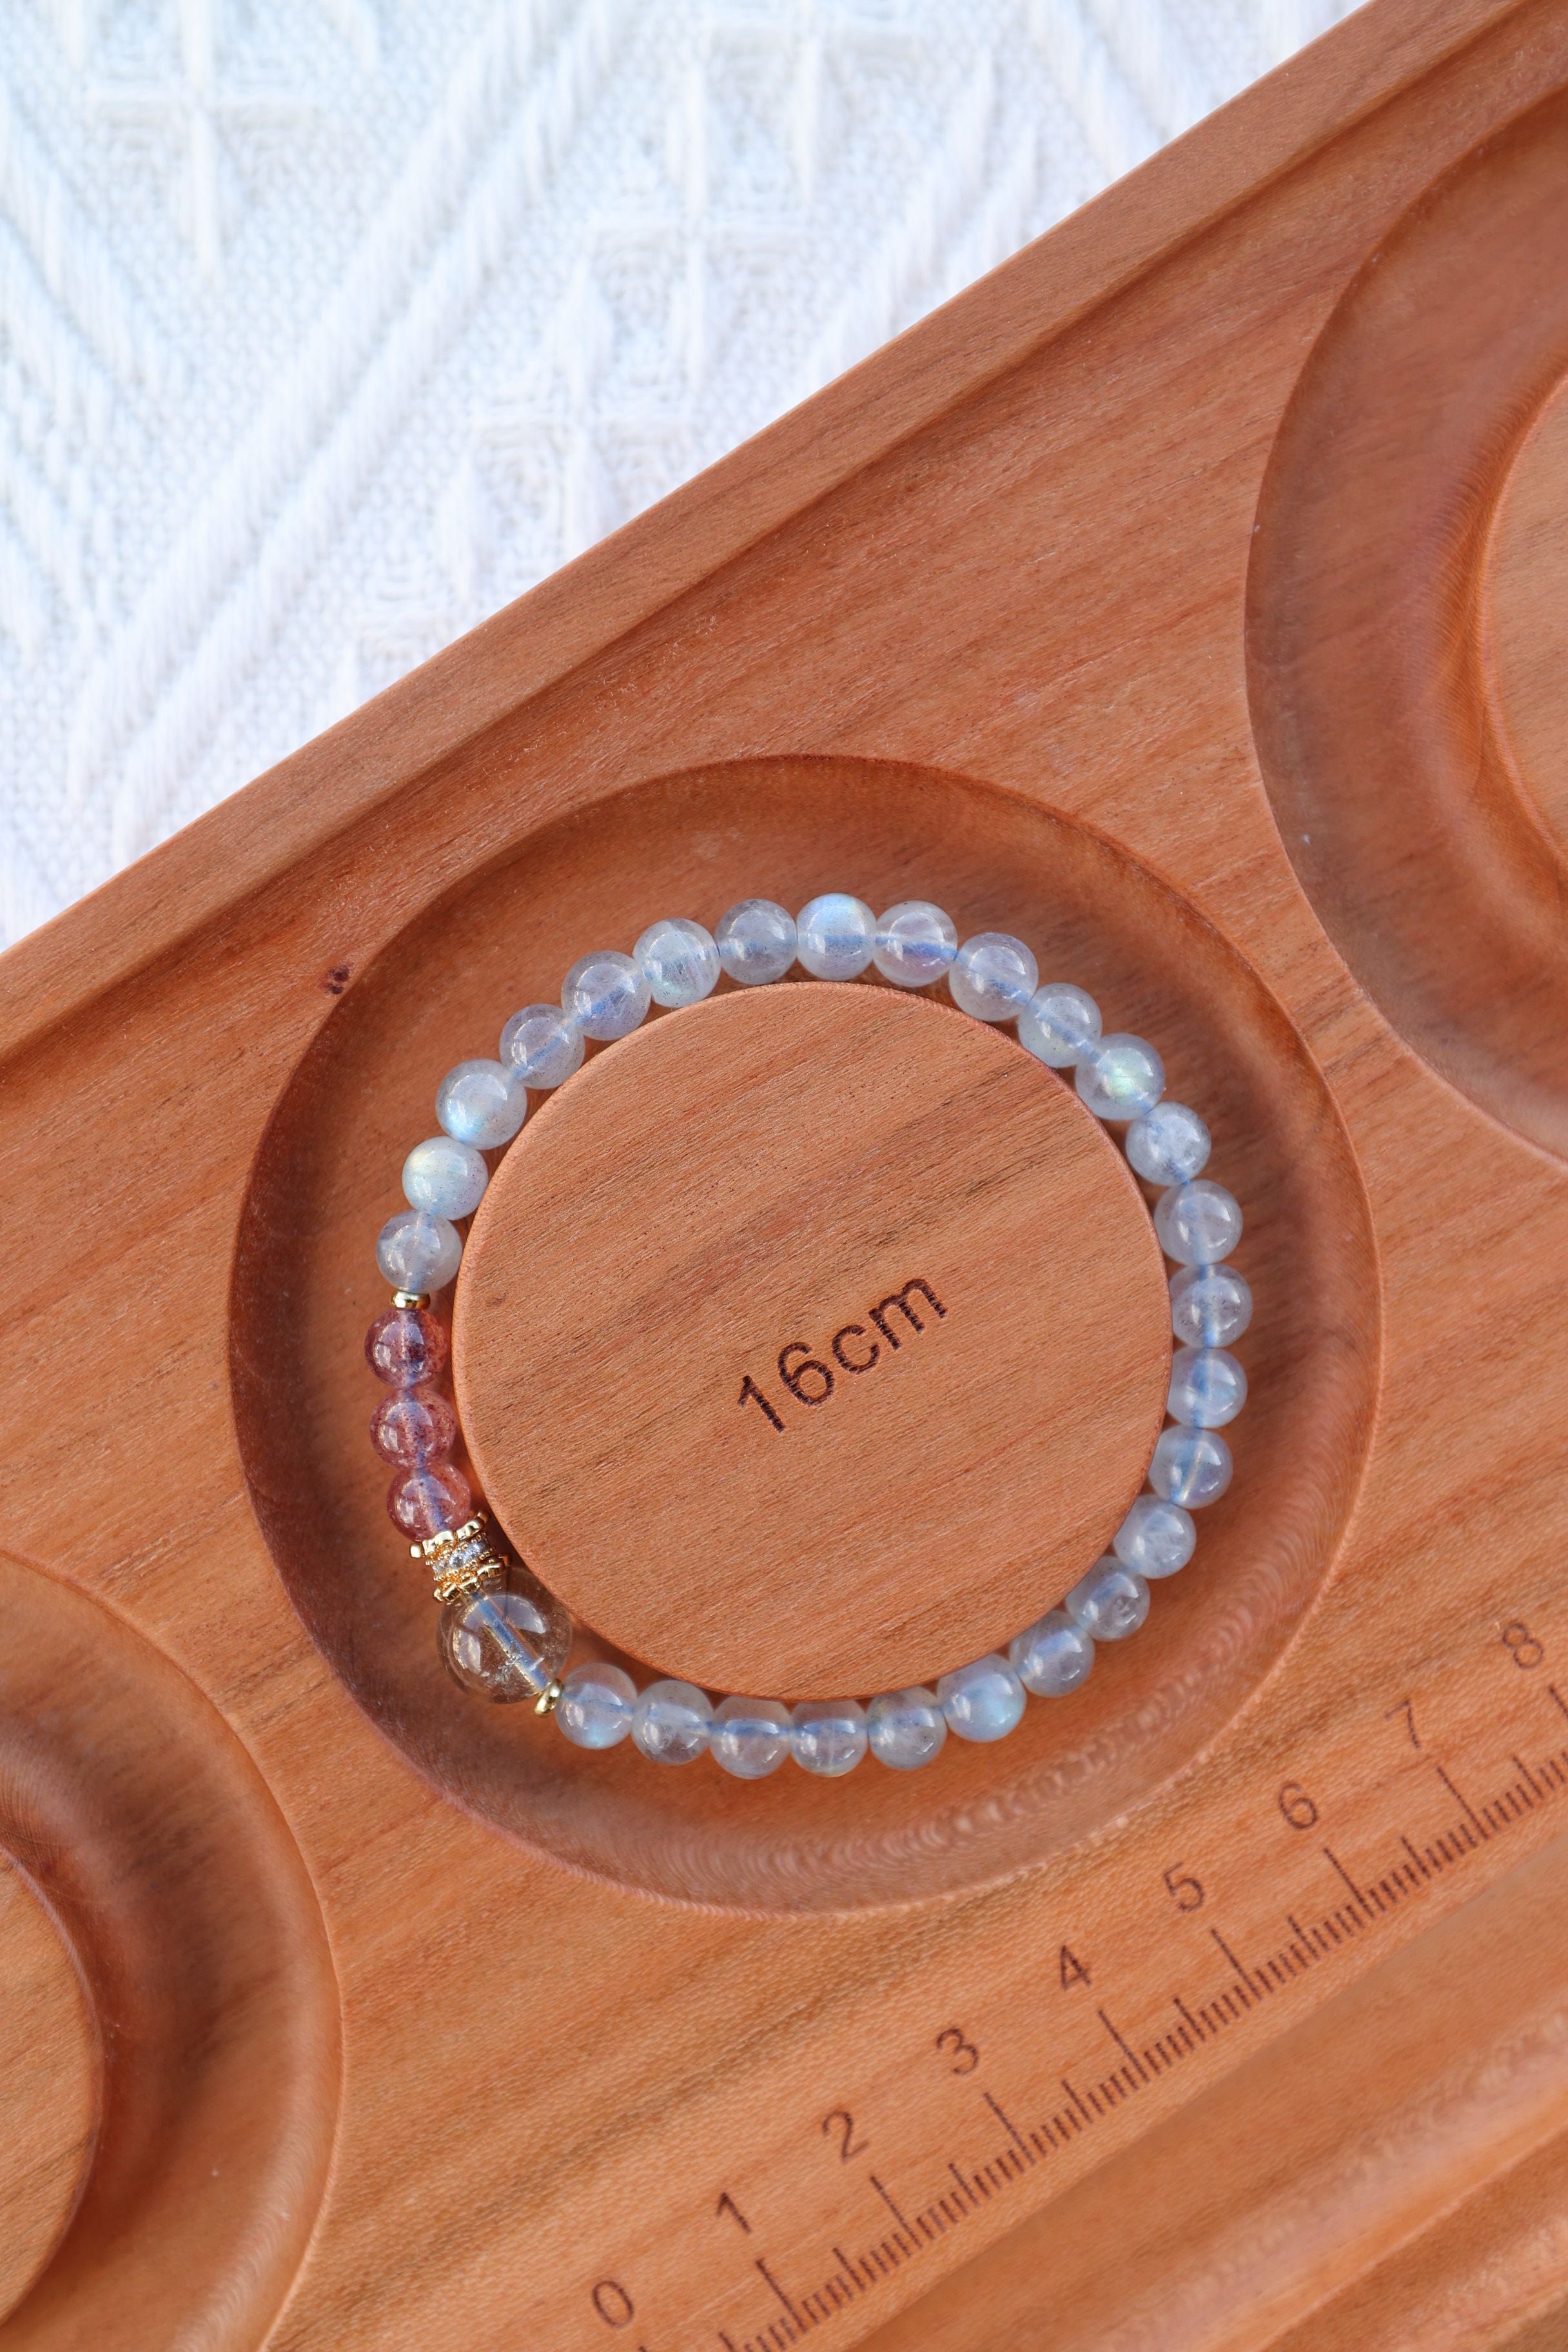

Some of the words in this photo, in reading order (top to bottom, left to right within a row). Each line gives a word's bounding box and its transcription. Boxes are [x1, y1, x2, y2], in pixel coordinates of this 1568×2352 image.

[737, 1279, 948, 1433] 16cm
[591, 2280, 634, 2329] 0
[716, 2192, 750, 2234] 1
[821, 2110, 870, 2164] 2
[936, 2028, 979, 2075] 3
[1059, 1944, 1092, 1991] 4
[1164, 1861, 1206, 1913] 5
[1279, 1782, 1319, 1830] 6
[1384, 1699, 1420, 1749] 7
[1502, 1622, 1543, 1669] 8
